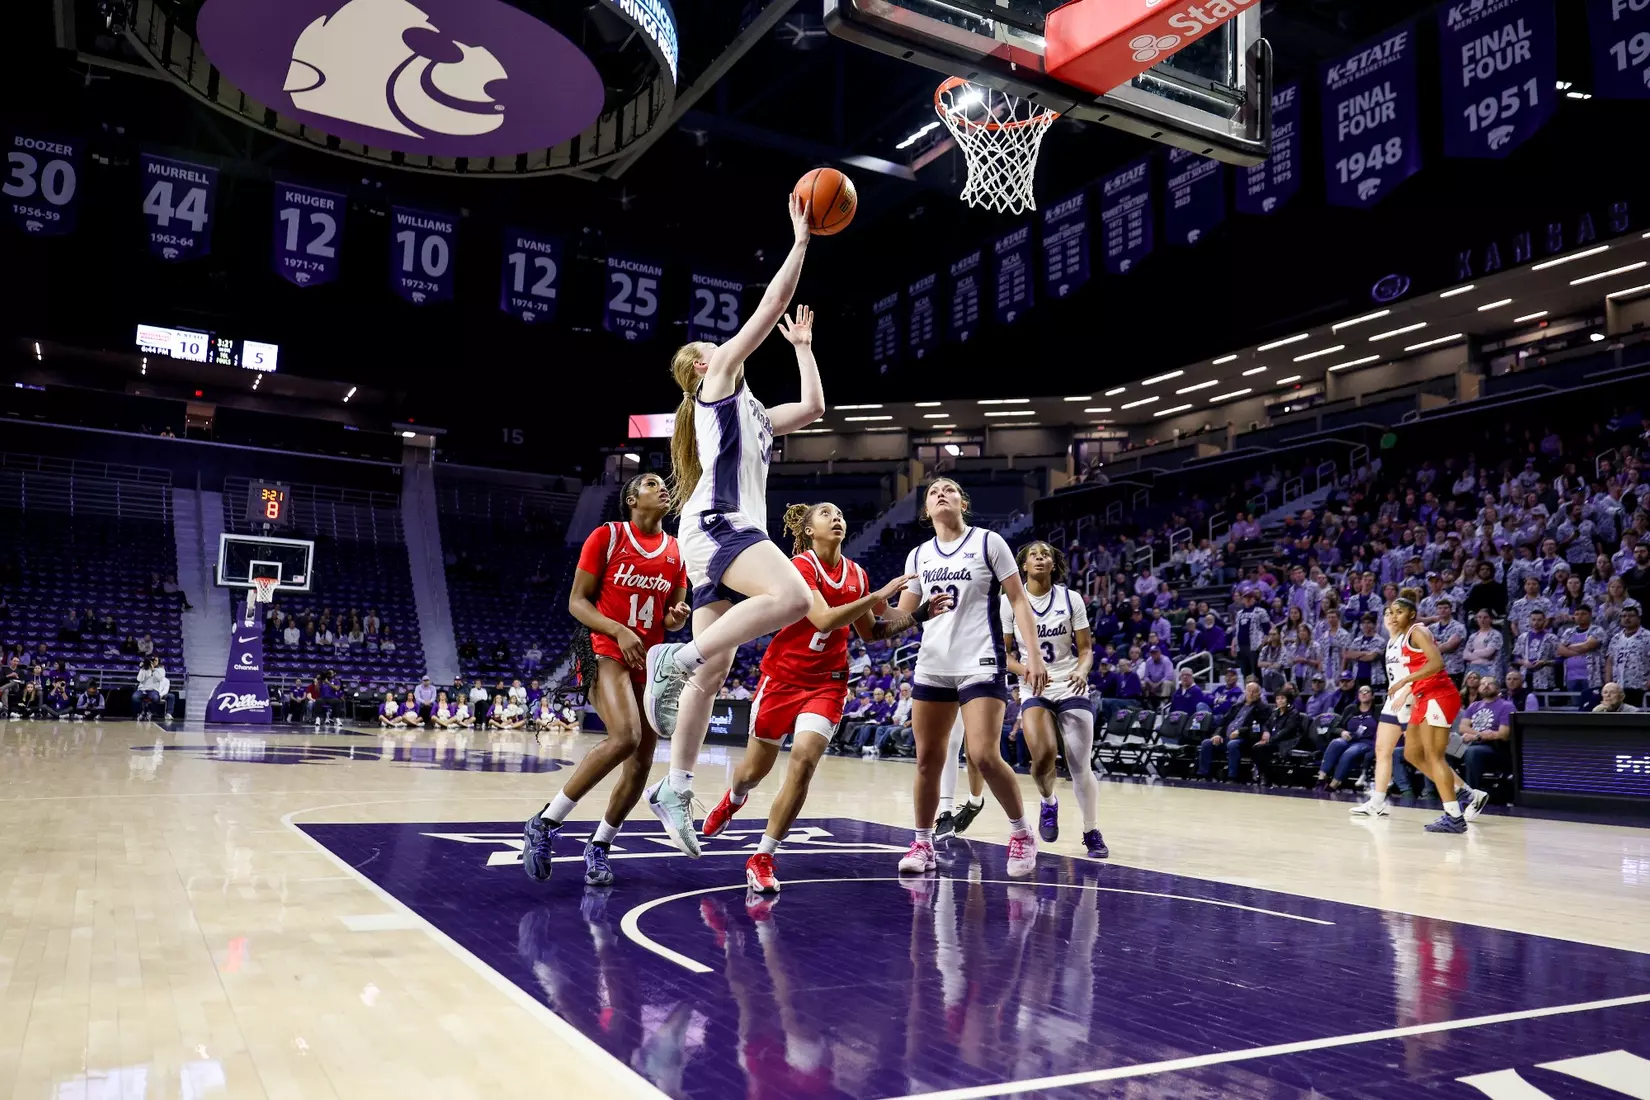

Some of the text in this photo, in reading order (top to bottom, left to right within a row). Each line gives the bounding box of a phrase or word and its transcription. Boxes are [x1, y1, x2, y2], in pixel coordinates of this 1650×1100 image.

[1168, 0, 1256, 37] Sta
[1461, 17, 1532, 66] FINAL
[1609, 32, 1650, 71] 19
[1326, 31, 1409, 86] K-STATE
[1462, 39, 1532, 87] FOUR
[1338, 80, 1398, 121] FINAL
[1463, 77, 1538, 132] 1951
[1339, 100, 1396, 142] FOUR
[14, 136, 74, 157] BOOZER
[1335, 136, 1403, 184] 1948
[2, 151, 77, 205] 30
[147, 162, 209, 185] MURRELL
[1103, 162, 1147, 193] K-STATE
[12, 203, 61, 221] 1956-59
[142, 180, 209, 232] 44
[285, 190, 335, 211] KRUGER
[1044, 192, 1084, 221] K-STATE
[280, 207, 337, 258] 12
[396, 213, 453, 234] WILLIAMS
[150, 232, 194, 248] 1962-64
[516, 237, 552, 255] EVANS
[284, 257, 325, 273] 1971-74
[396, 230, 450, 278] 10
[508, 251, 557, 299] 12
[607, 256, 663, 277] BLACKMAN
[400, 278, 439, 293] 1972-76
[692, 273, 743, 292] RICHMOND
[511, 297, 549, 313] 1974-78
[608, 272, 658, 317] 25
[693, 288, 739, 332] 23
[179, 341, 200, 355] 10
[254, 352, 264, 364] 5
[501, 427, 525, 445] 15
[261, 488, 284, 502] 3:21
[265, 501, 279, 519] 8
[613, 562, 672, 593] Houston
[922, 566, 972, 584] Wildcats
[627, 593, 655, 629] 14
[1036, 622, 1068, 638] ldcats
[1040, 641, 1056, 664] 3
[233, 663, 260, 672] Channel
[216, 692, 270, 713] Dillons
